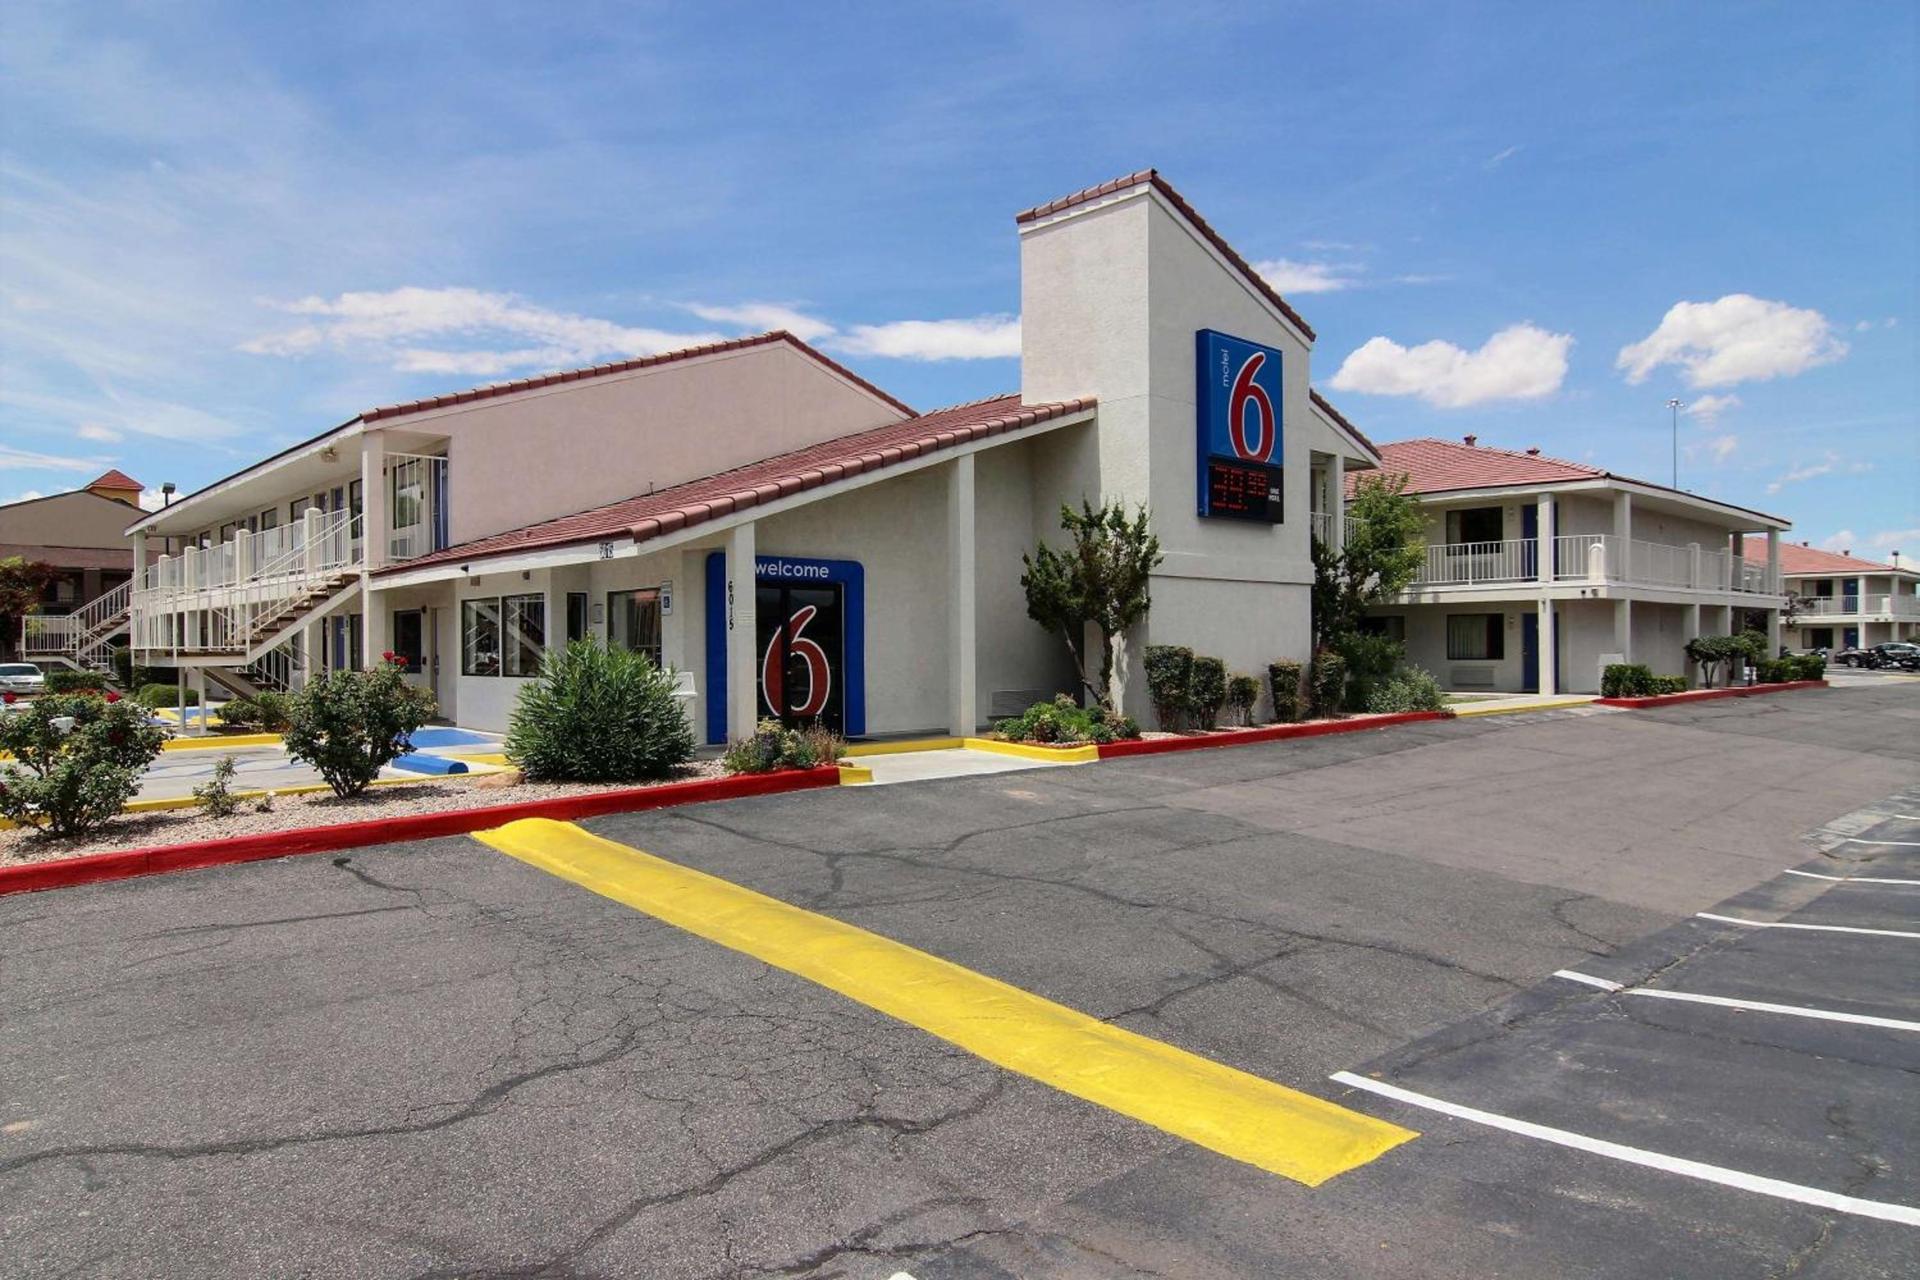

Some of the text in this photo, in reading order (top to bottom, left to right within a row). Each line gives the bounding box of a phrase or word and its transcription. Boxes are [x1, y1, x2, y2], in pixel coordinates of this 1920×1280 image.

[1220, 348, 1230, 388] motel
[1228, 351, 1275, 463] 6
[755, 560, 829, 578] welcome
[762, 605, 831, 717] 6
